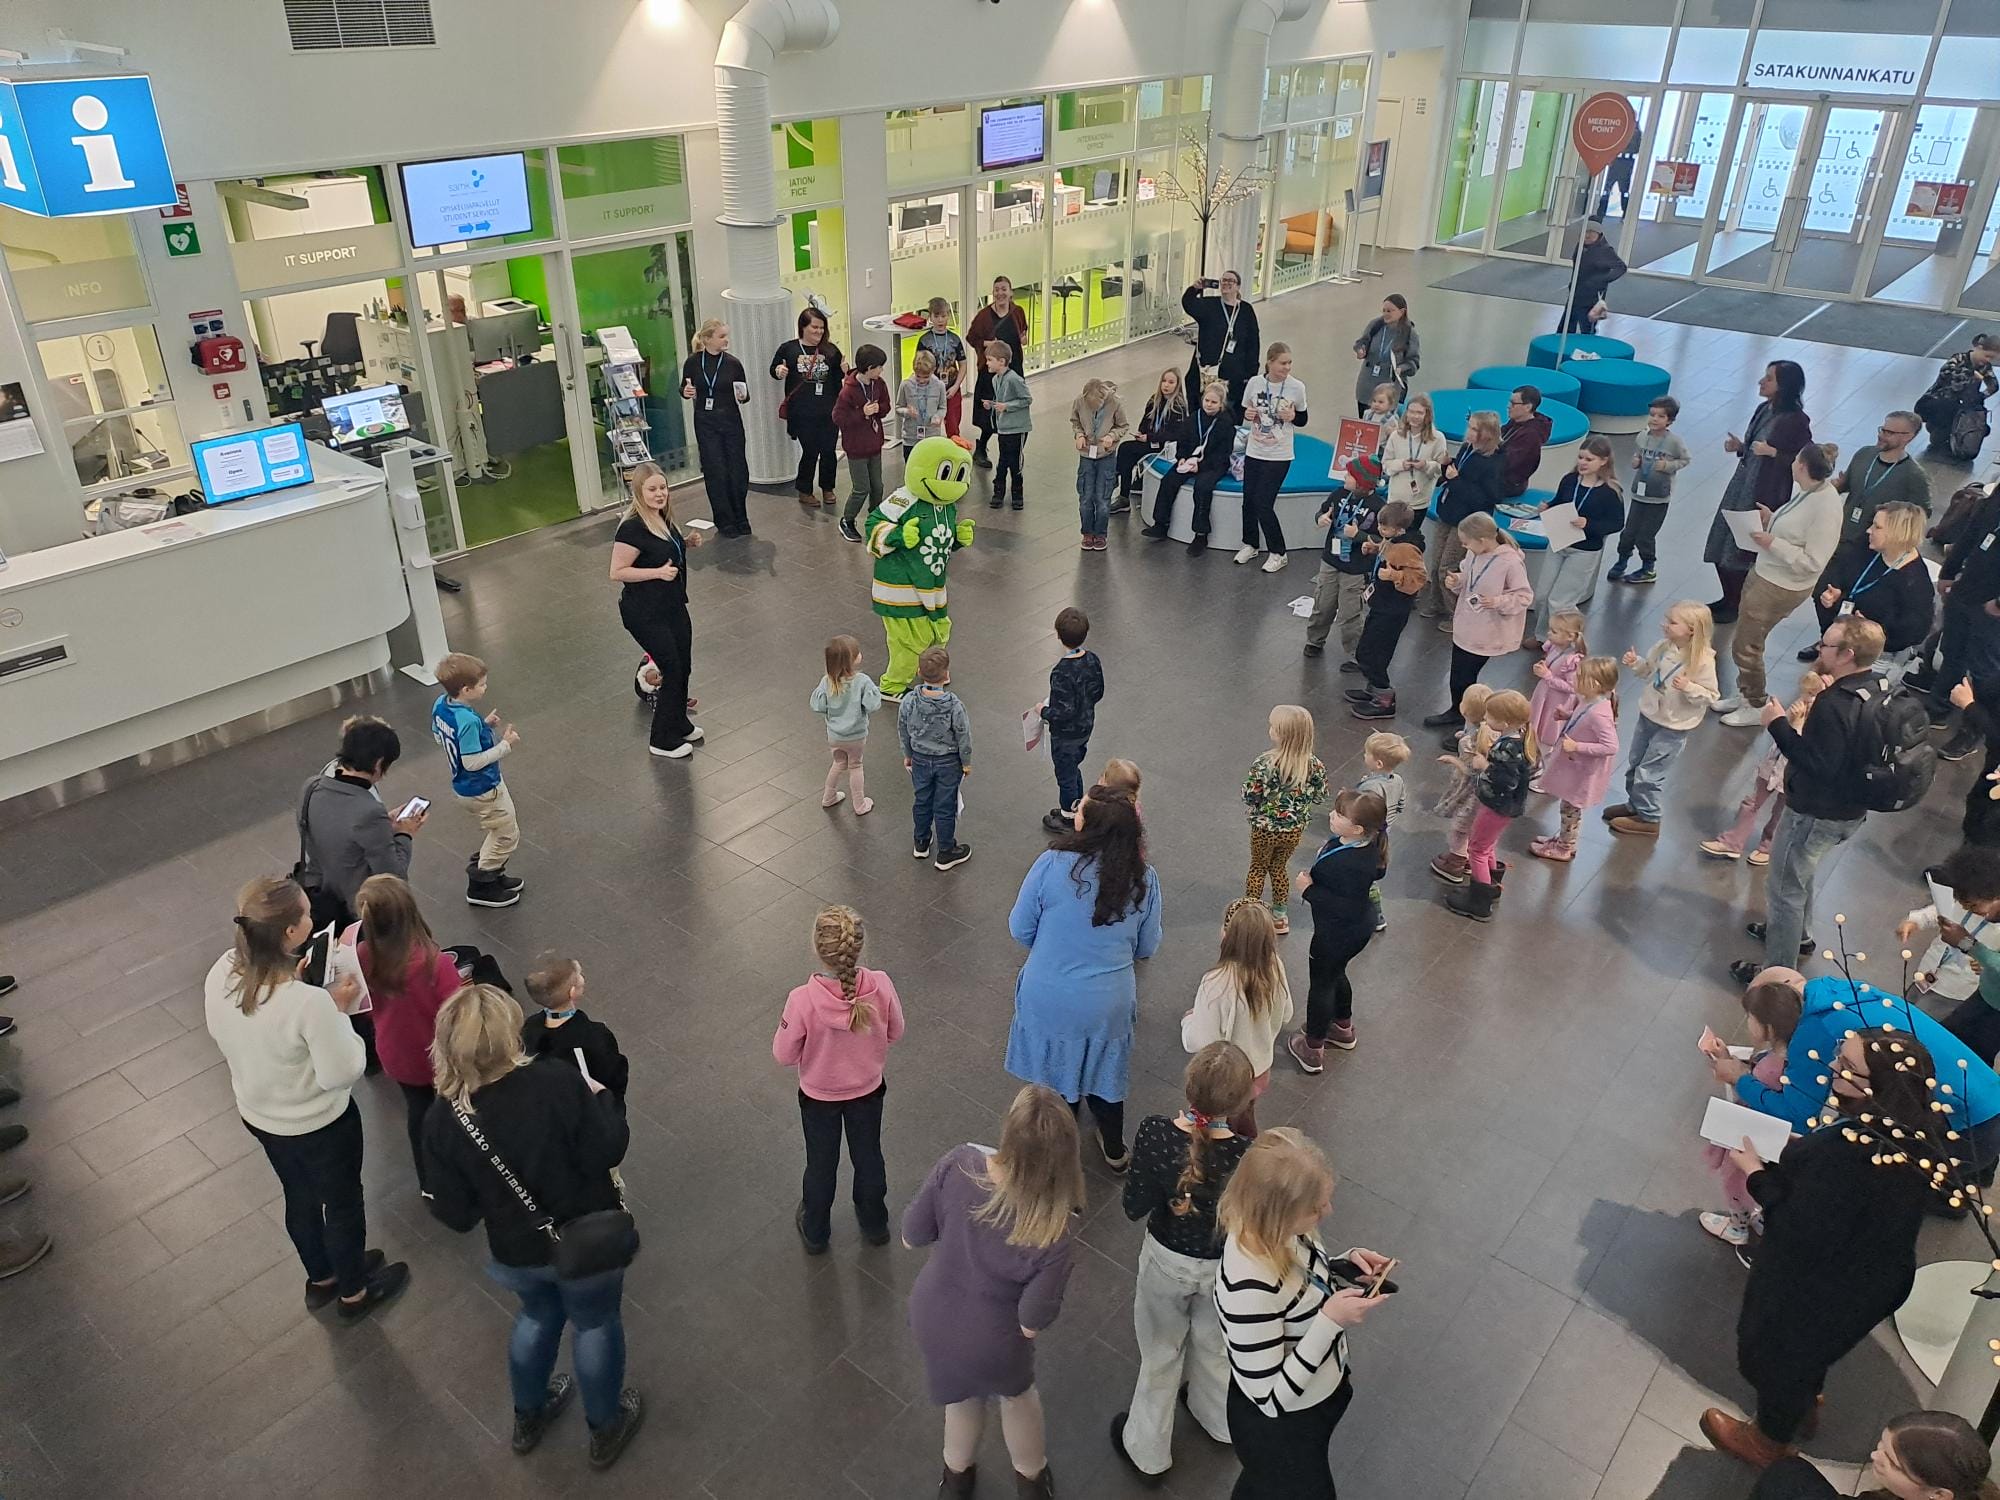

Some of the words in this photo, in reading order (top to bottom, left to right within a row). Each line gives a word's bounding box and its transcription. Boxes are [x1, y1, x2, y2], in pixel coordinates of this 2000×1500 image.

[1753, 63, 1915, 85] SATAKUNNANKATU
[1587, 117, 1621, 126] MEETING
[1591, 125, 1615, 133] POINT
[603, 210, 610, 220] IT
[614, 204, 654, 219] SUPPORT
[284, 255, 296, 267] IT
[299, 246, 357, 265] SUPPORT
[64, 281, 102, 297] INFO
[490, 1154, 537, 1212] marimekko
